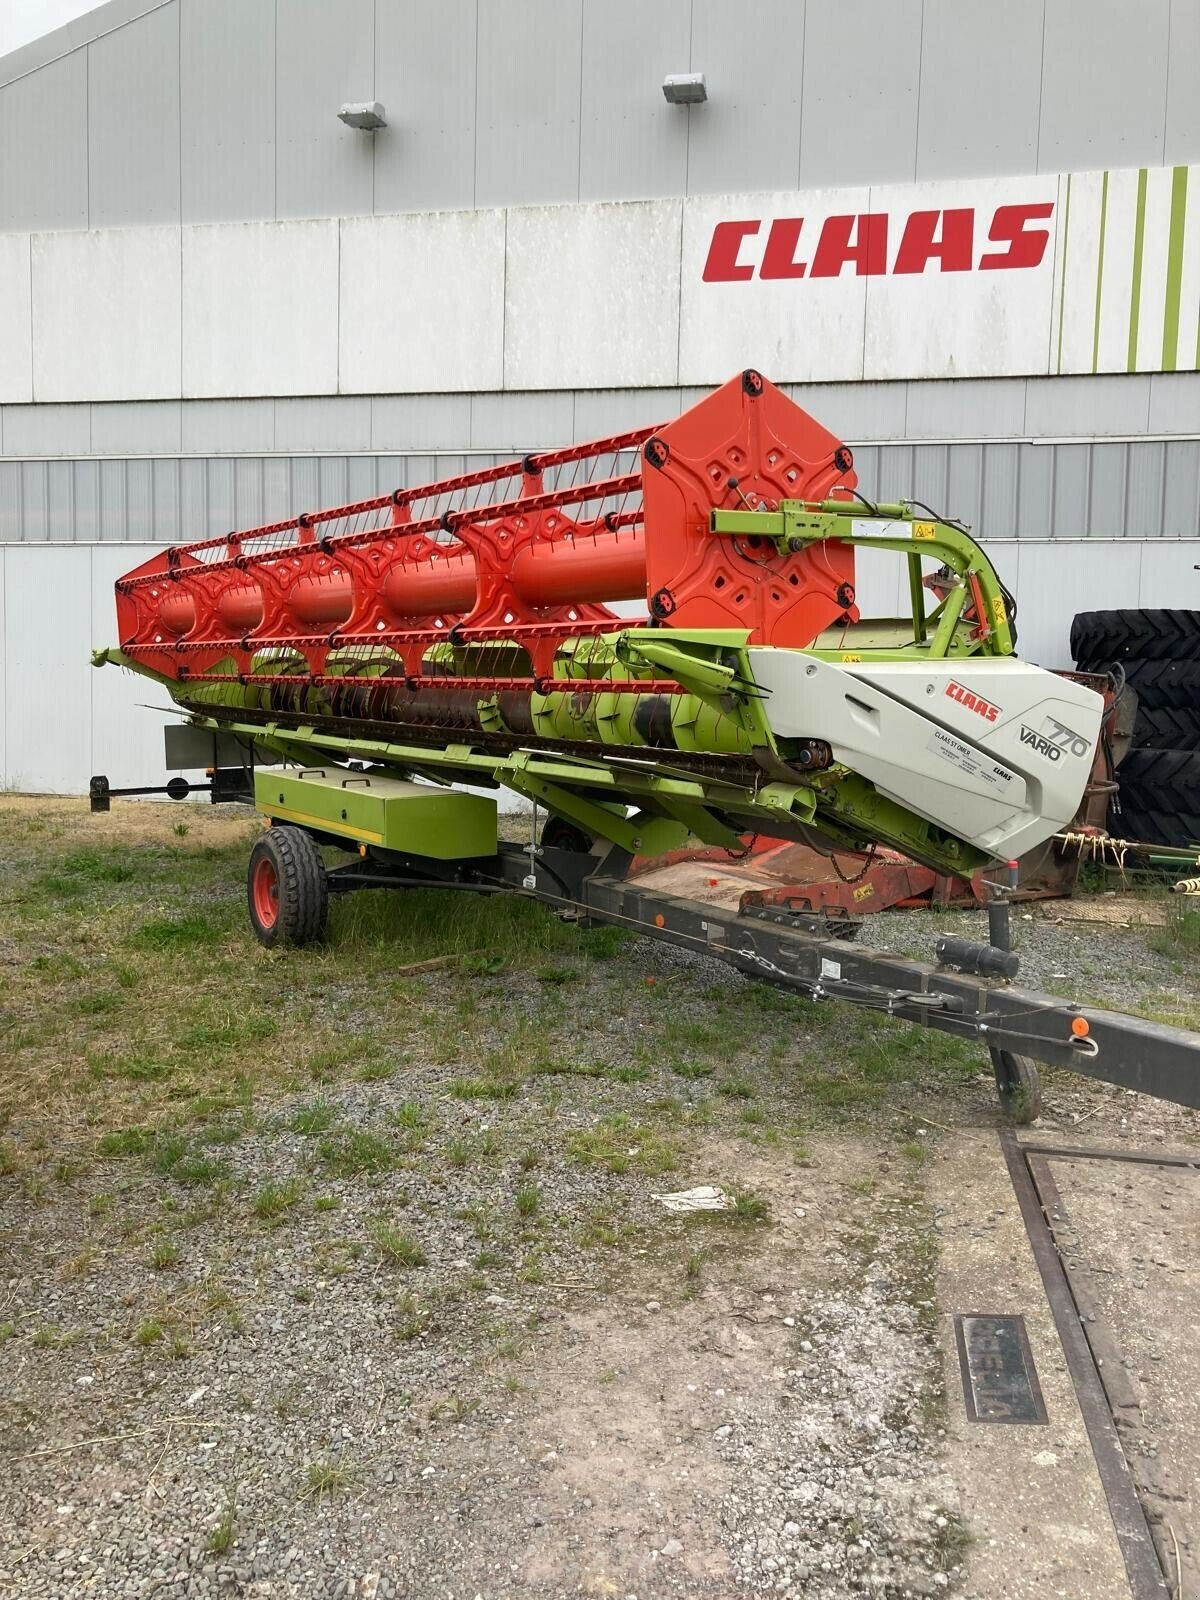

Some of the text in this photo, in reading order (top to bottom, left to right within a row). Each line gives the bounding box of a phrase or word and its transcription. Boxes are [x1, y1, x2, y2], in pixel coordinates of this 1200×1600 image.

[702, 202, 1055, 282] CLAAS
[945, 683, 999, 722] CLAAS
[934, 731, 951, 745] CLAAS
[1019, 727, 1061, 762] VARIO
[1047, 722, 1088, 758] 770
[993, 767, 1013, 781] CLAAS
